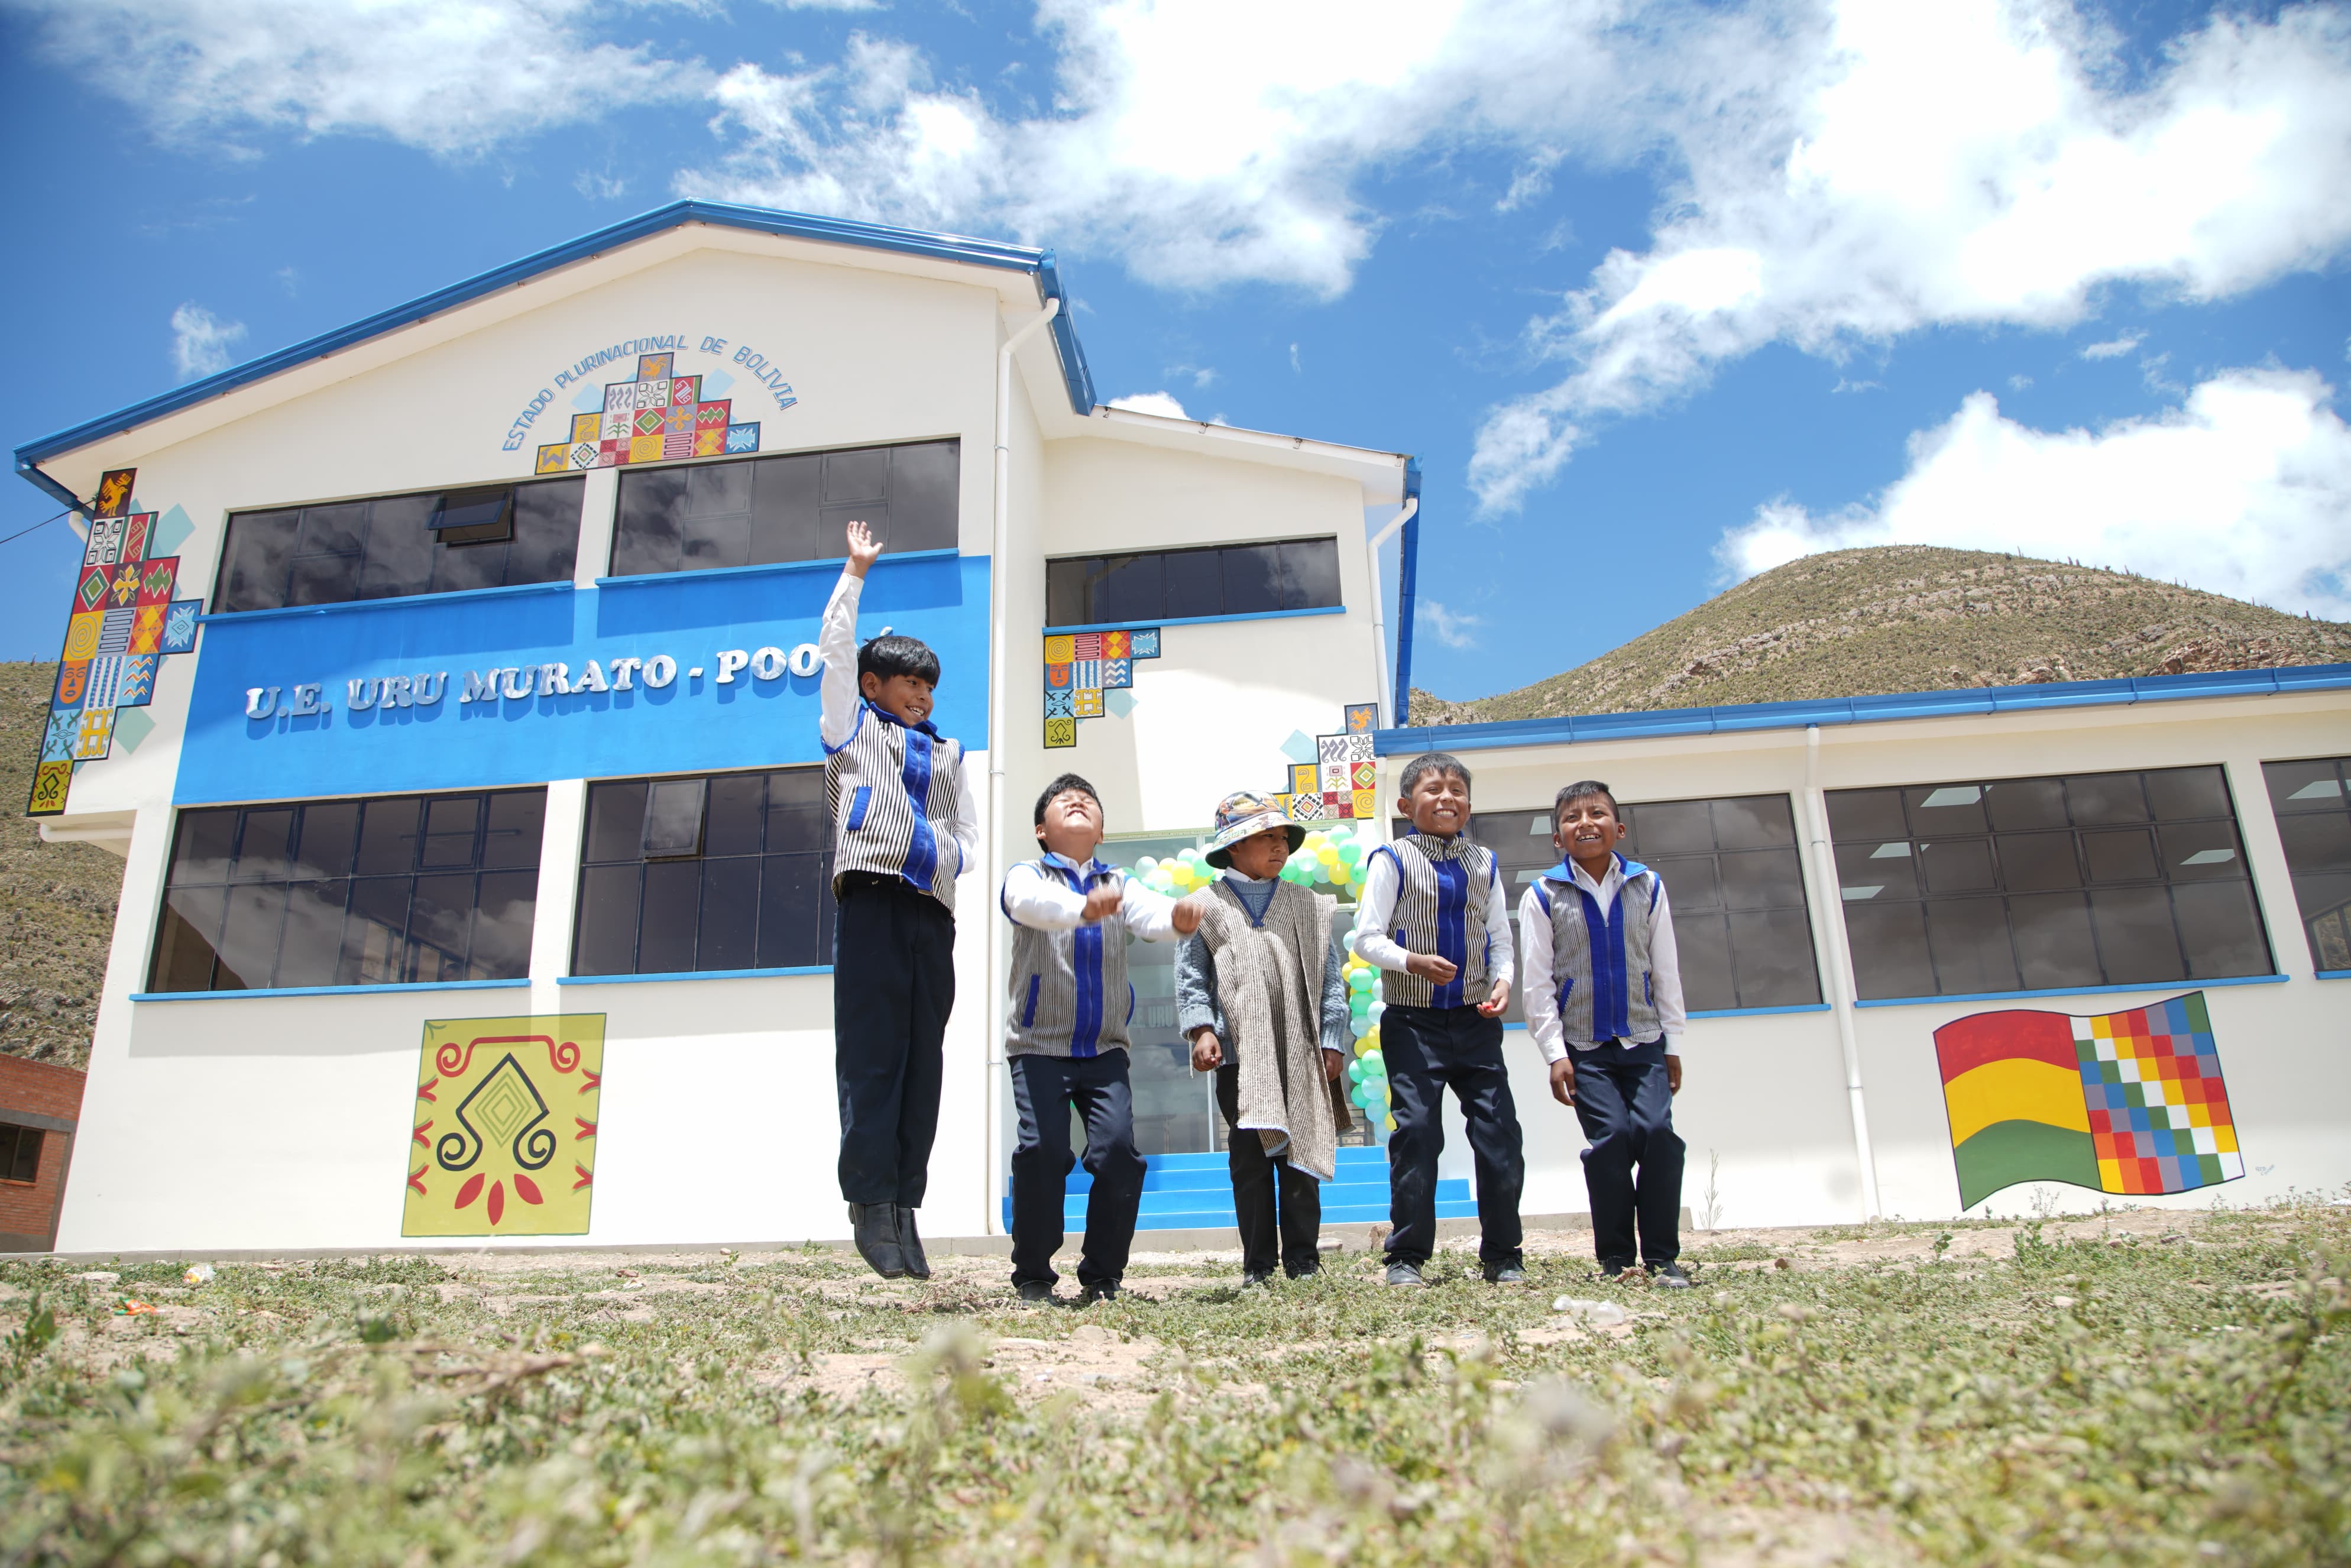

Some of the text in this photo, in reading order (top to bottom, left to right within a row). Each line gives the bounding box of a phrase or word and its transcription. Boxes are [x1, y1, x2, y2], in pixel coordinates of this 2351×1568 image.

[501, 335, 798, 451] ESTADO PLURINACIONAL DE BOLIVIA
[246, 643, 860, 720] U.E. URU MURATO - POO
[1148, 1006, 1173, 1028] URU
